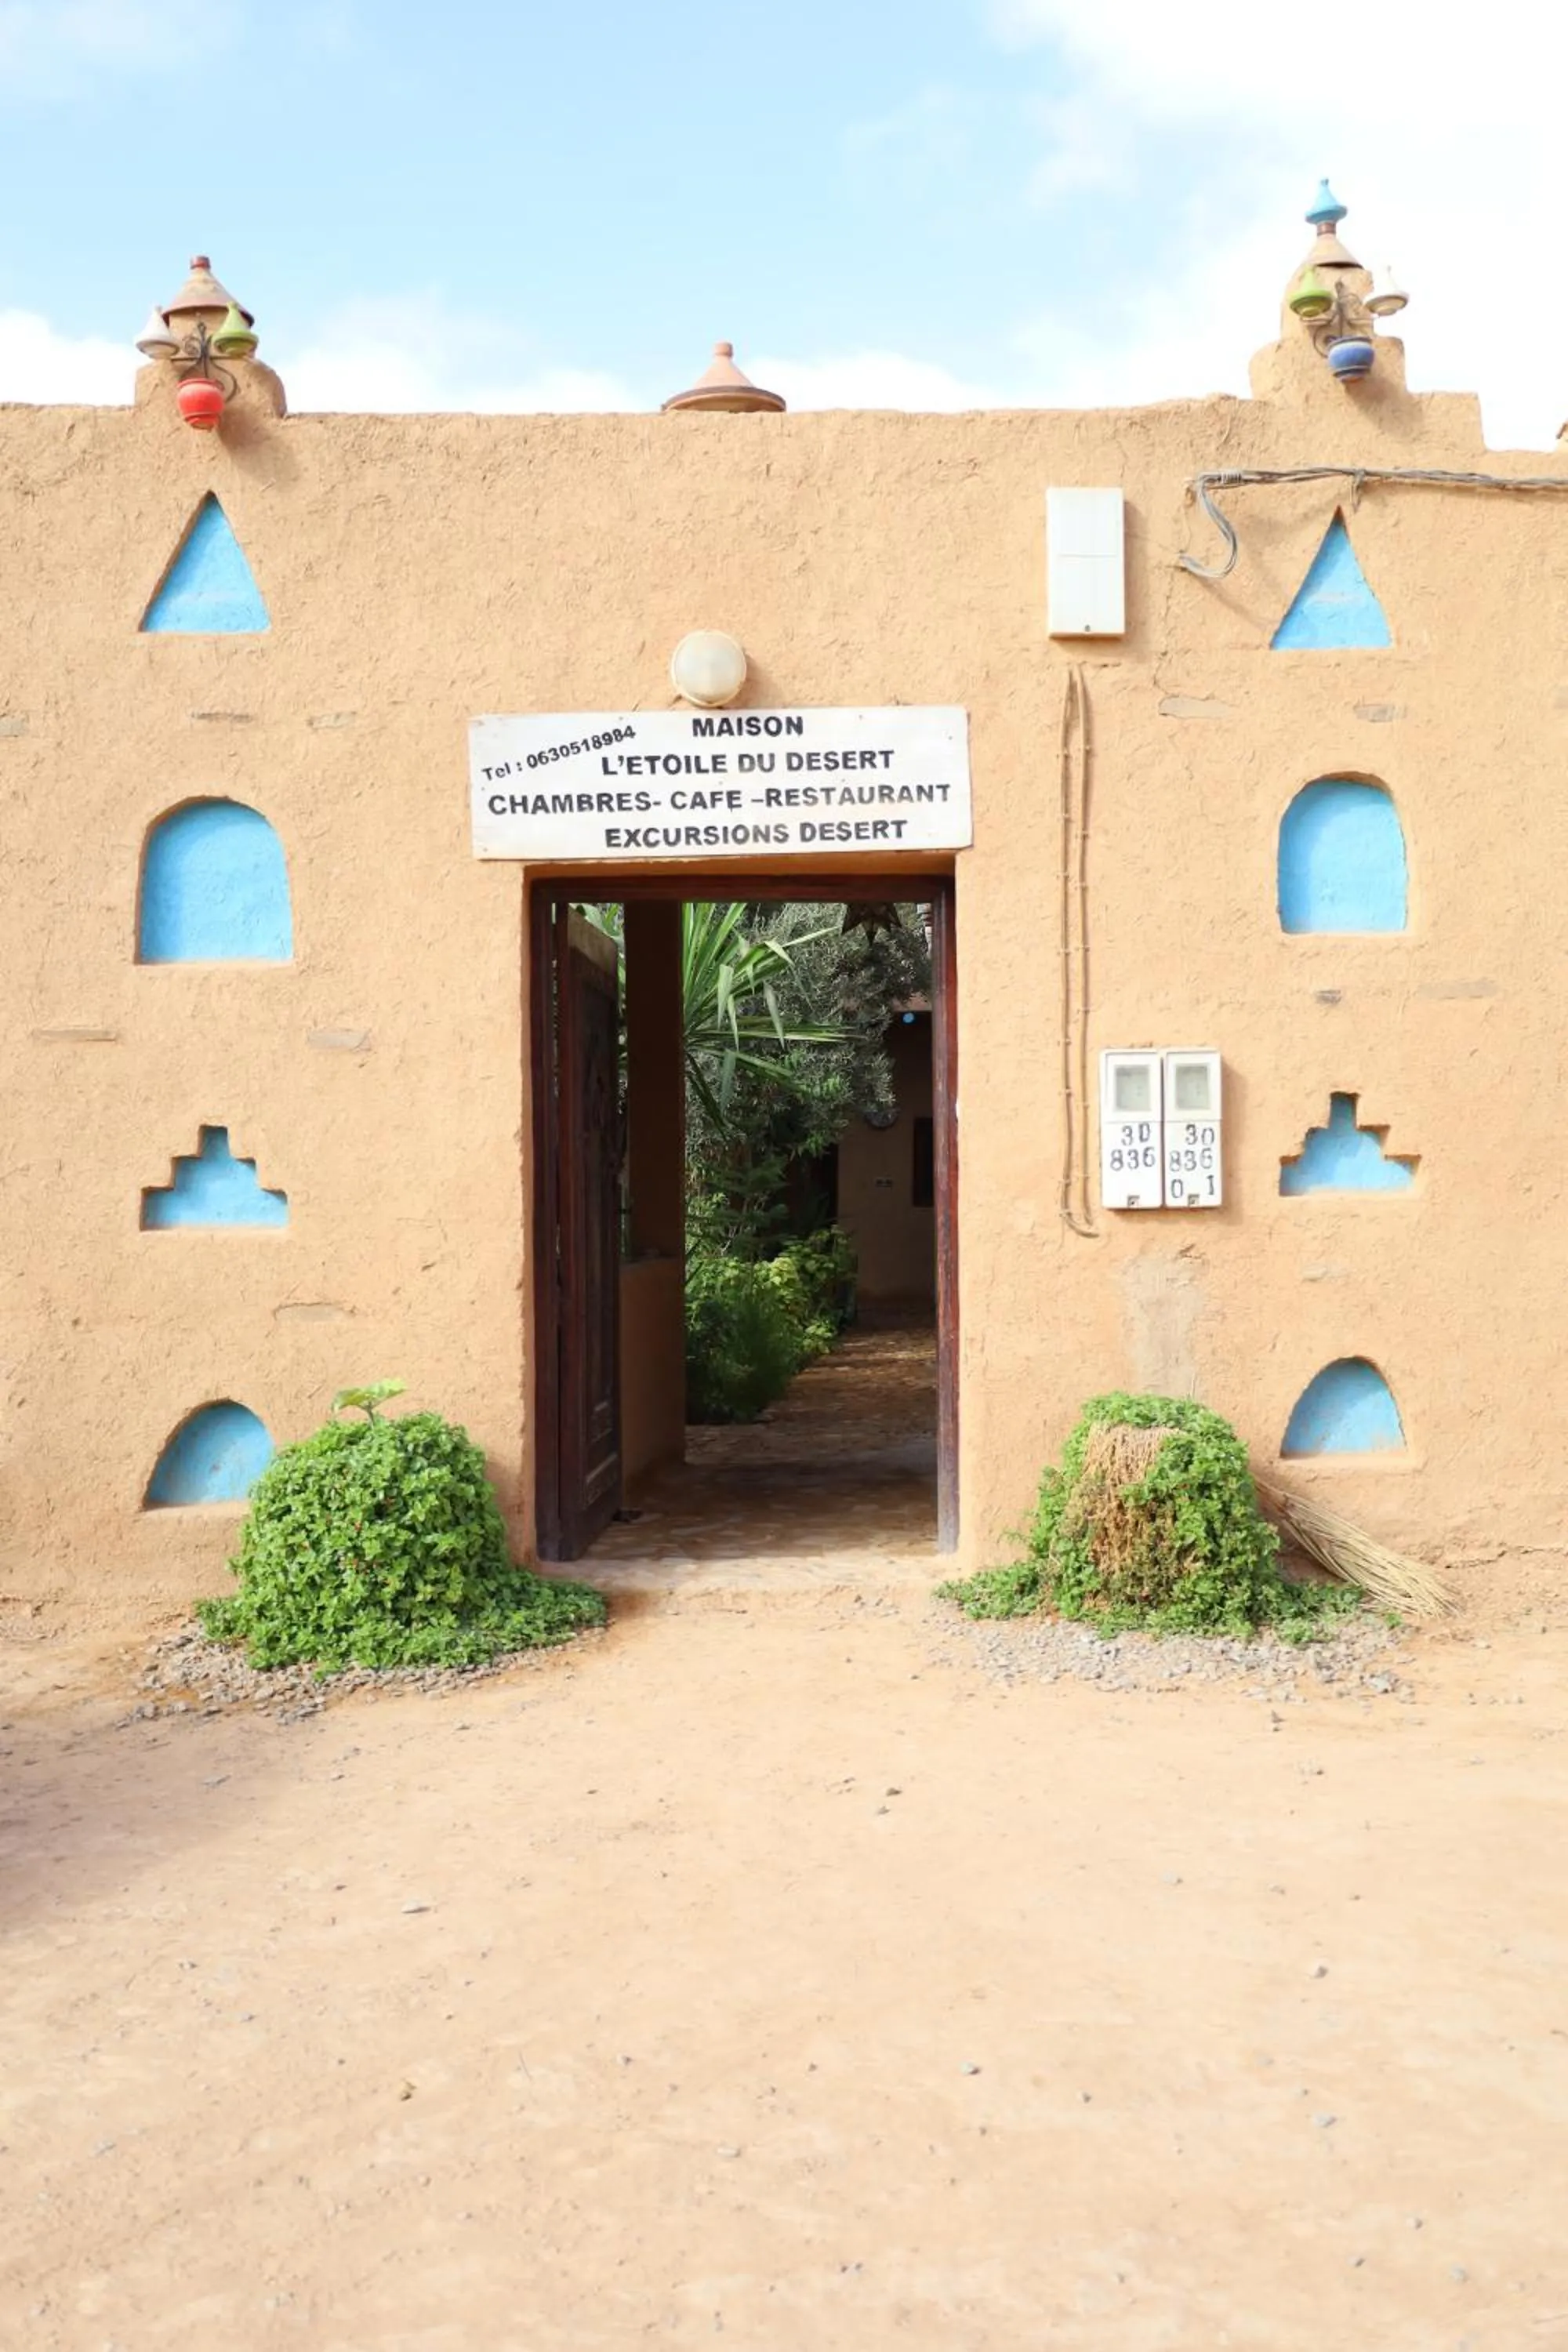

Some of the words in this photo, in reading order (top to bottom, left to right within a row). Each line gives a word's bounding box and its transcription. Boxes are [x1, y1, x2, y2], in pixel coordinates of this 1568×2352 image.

[692, 716, 804, 737] MAISON
[481, 762, 511, 781] Tel
[526, 724, 637, 769] 0630518984
[601, 753, 728, 775] L'ETOILE
[738, 753, 775, 773] DU
[786, 750, 895, 771] DESERT
[488, 791, 662, 815] CHAMBRES-
[670, 789, 742, 811] CAFE
[604, 823, 790, 848] EXCURSIONS
[799, 819, 908, 843] DESERT
[1185, 1123, 1216, 1145] 30
[1109, 1146, 1156, 1171] 836
[1169, 1147, 1214, 1172] 836
